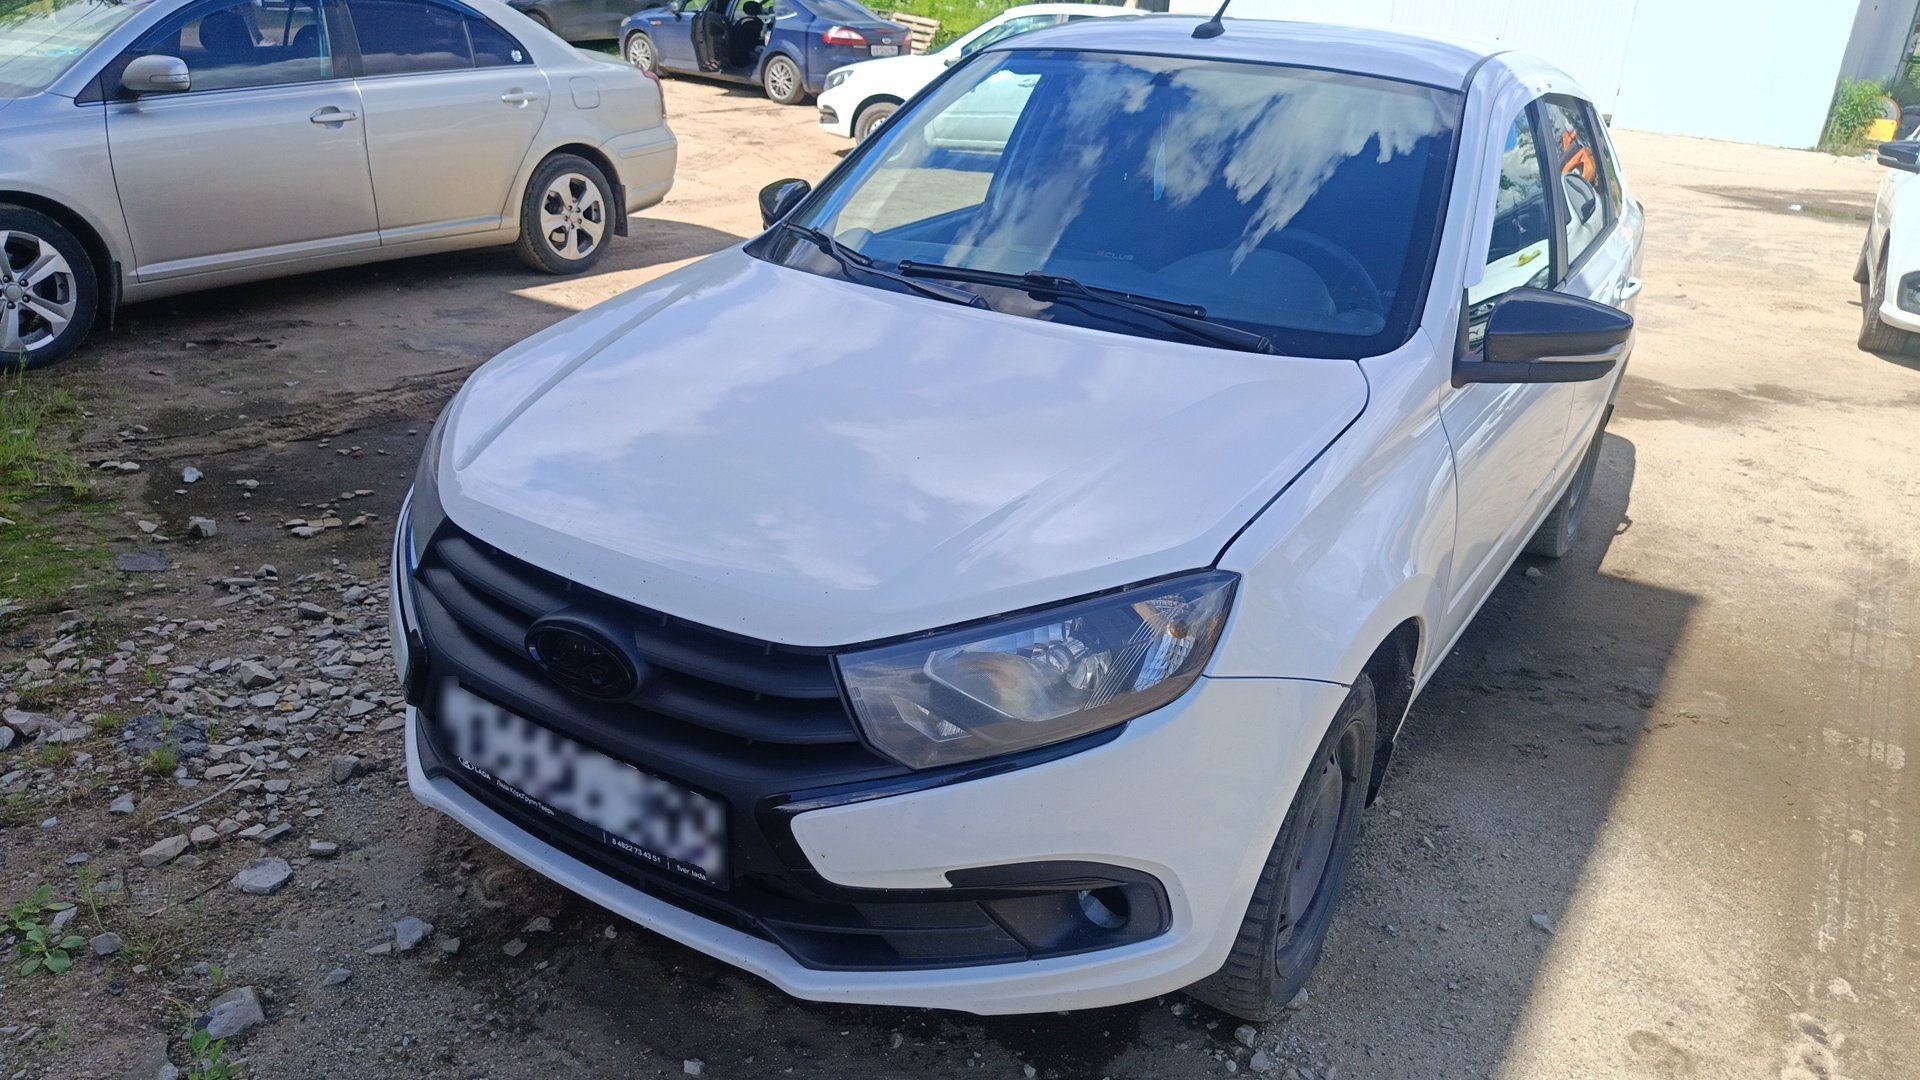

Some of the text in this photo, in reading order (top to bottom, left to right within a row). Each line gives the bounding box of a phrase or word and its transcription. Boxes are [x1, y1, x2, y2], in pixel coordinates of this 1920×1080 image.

[474, 766, 491, 780] LADA
[617, 841, 633, 852] 4822
[633, 847, 643, 856] 73
[643, 852, 652, 860] 43
[652, 855, 661, 863] 51
